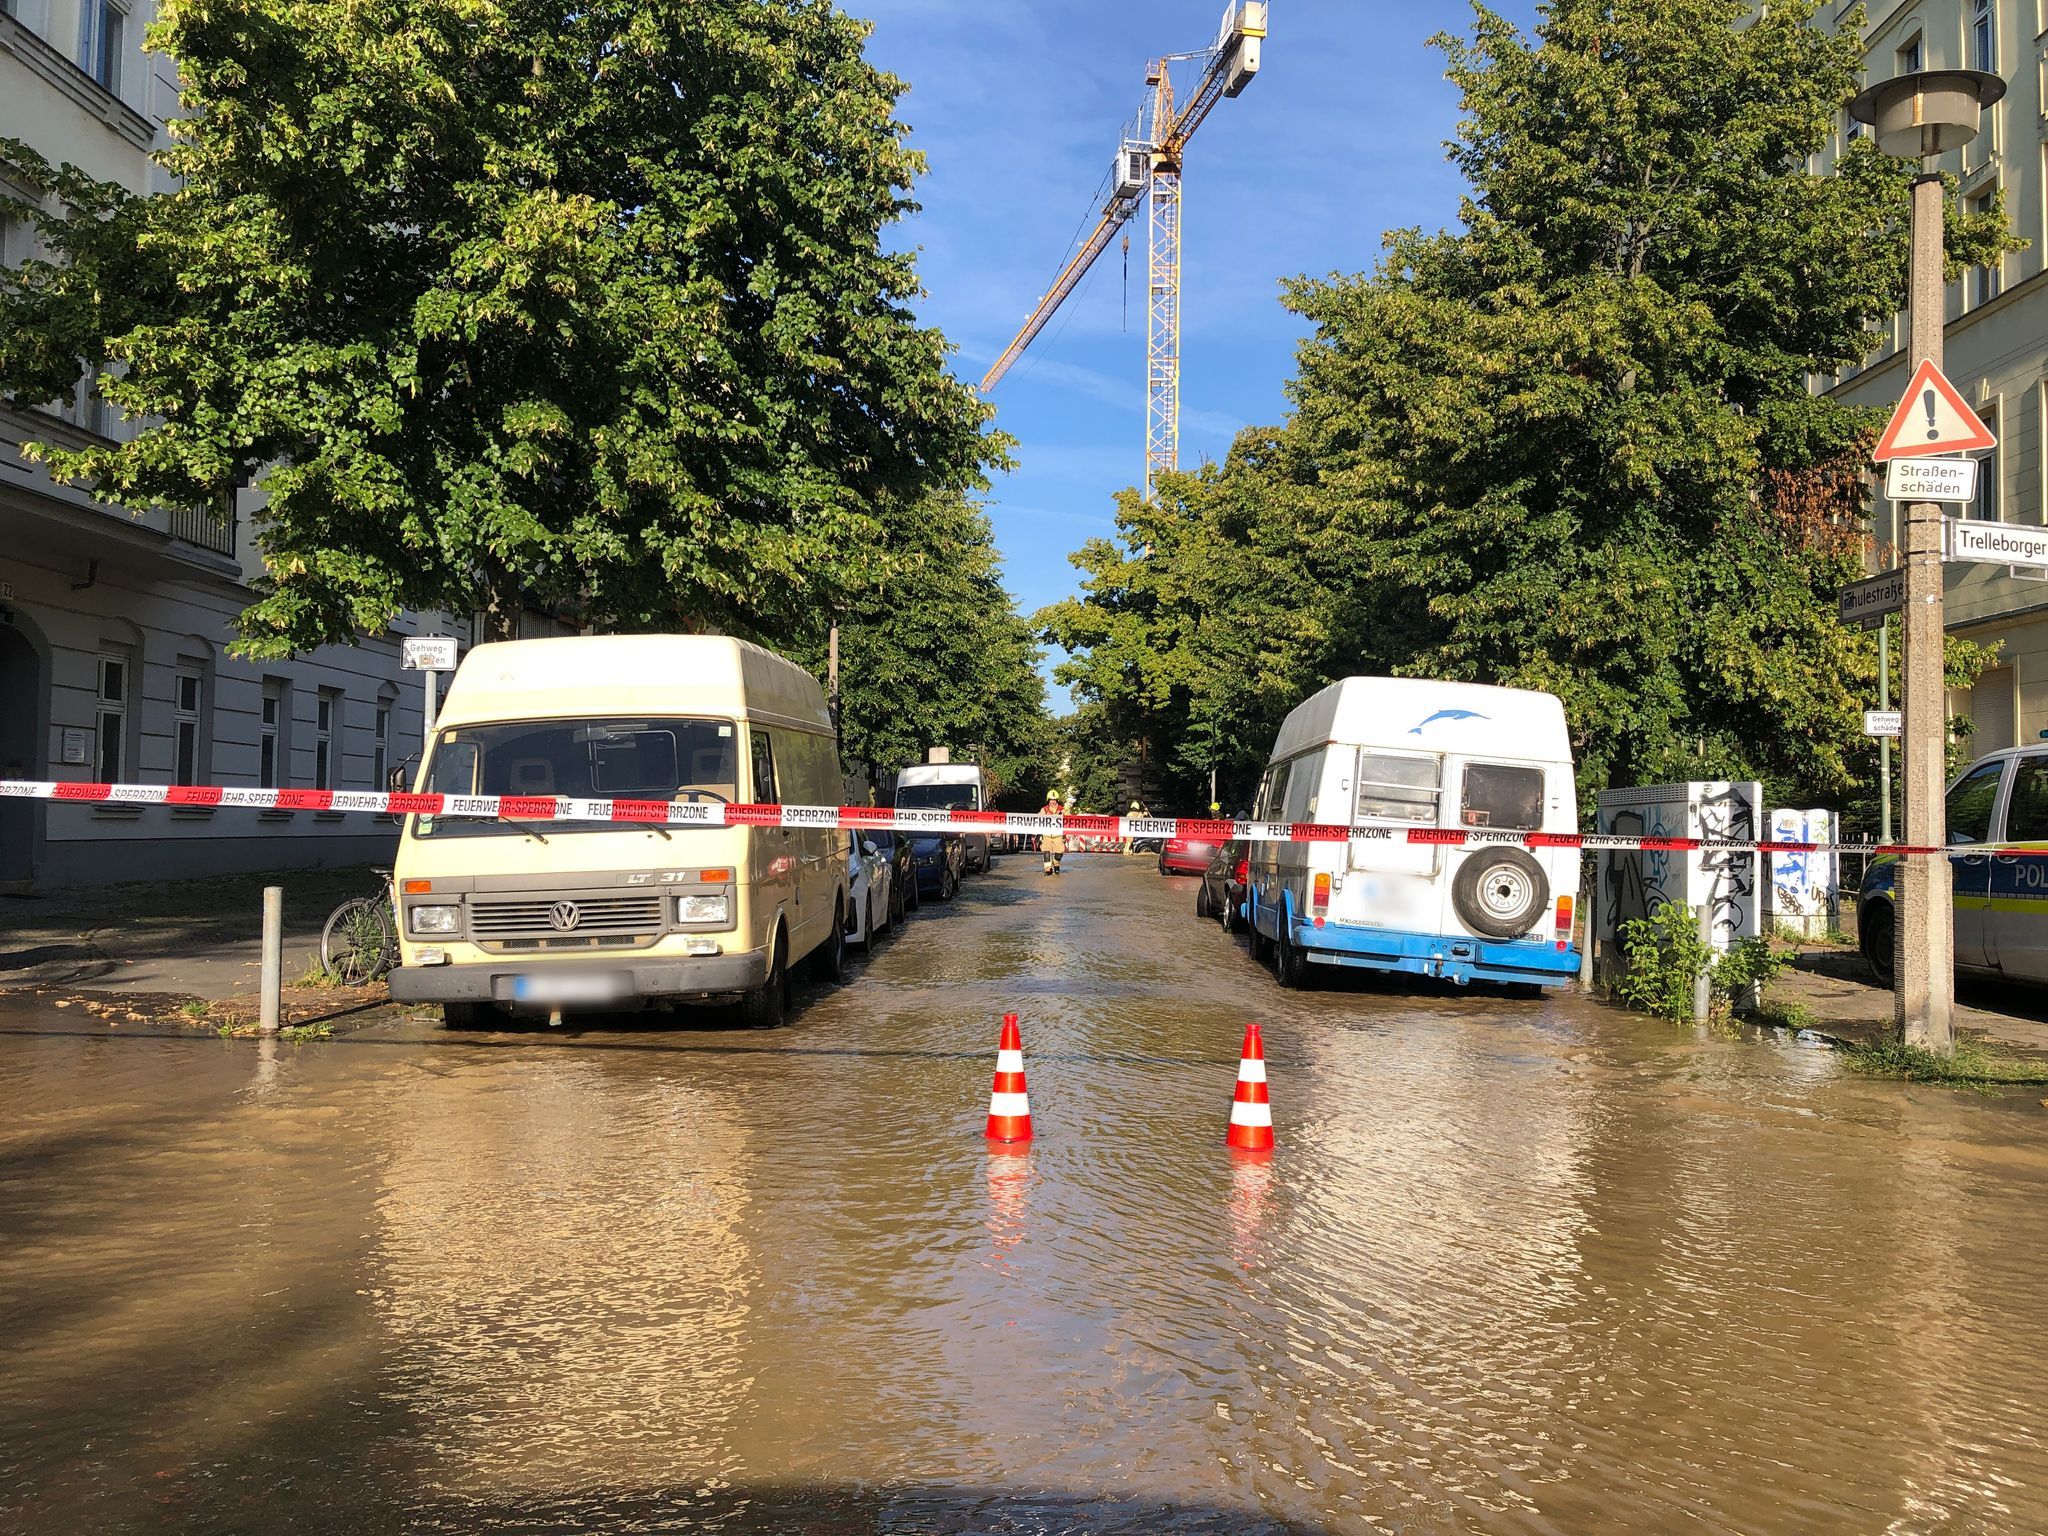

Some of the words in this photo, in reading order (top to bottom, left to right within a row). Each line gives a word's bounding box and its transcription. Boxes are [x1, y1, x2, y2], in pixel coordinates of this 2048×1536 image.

[1900, 464, 1964, 478] Straßen-
[1900, 480, 1960, 494] schäden
[1960, 530, 2047, 558] Trelleborger
[3, 583, 13, 597] 22
[410, 643, 447, 653] Gehweg-
[186, 791, 305, 806] FEUERWEHR-SPERRZONE
[318, 795, 438, 811] FEUERWEHR-SPERRZONE
[452, 800, 573, 815] FEUERWEHR-SPERRZONE
[587, 803, 709, 819] FEUERWEHR-SPERRZONE
[1129, 820, 1252, 835] FEUERWEHR-SPERRZONE
[1267, 824, 1392, 839] FEUERWEHR-SPERRZONE
[1407, 829, 1533, 843] FEUERWEHR-SPERRZONE
[626, 873, 652, 884] LT
[660, 871, 686, 882] 31
[2015, 864, 2048, 887] POL
